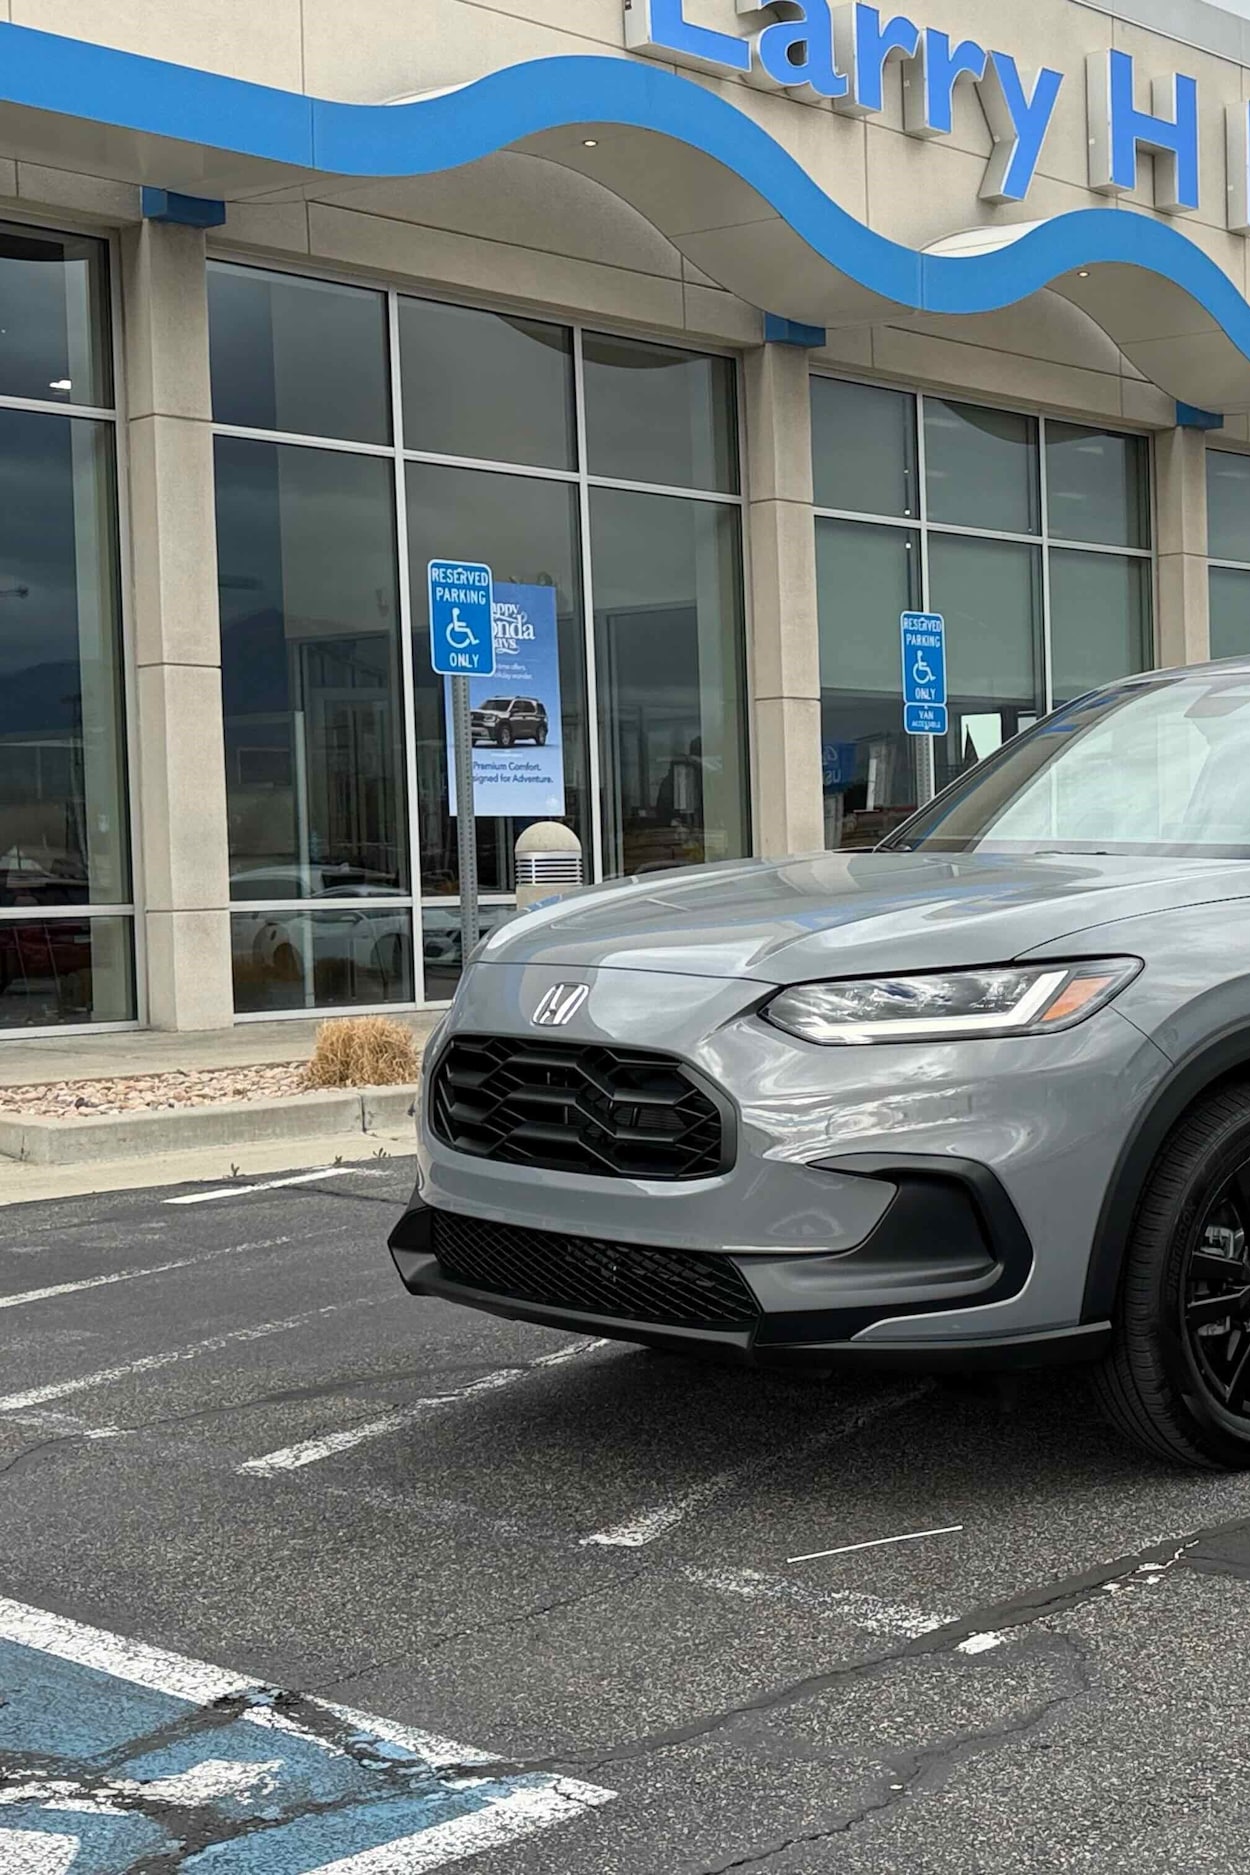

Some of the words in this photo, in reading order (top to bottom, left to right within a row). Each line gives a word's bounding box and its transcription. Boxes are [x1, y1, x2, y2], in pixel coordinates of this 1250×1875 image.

[1108, 47, 1200, 211] H
[431, 567, 489, 587] RESERVED
[435, 586, 487, 606] PARKING
[492, 614, 536, 640] nda
[903, 617, 942, 633] RESERVED
[905, 633, 941, 648] PARKING
[448, 652, 480, 669] ONLY
[914, 687, 936, 701] ONLY
[918, 710, 935, 720] VAN
[473, 761, 507, 771] Premium
[473, 773, 499, 785] signed
[500, 773, 511, 783] for
